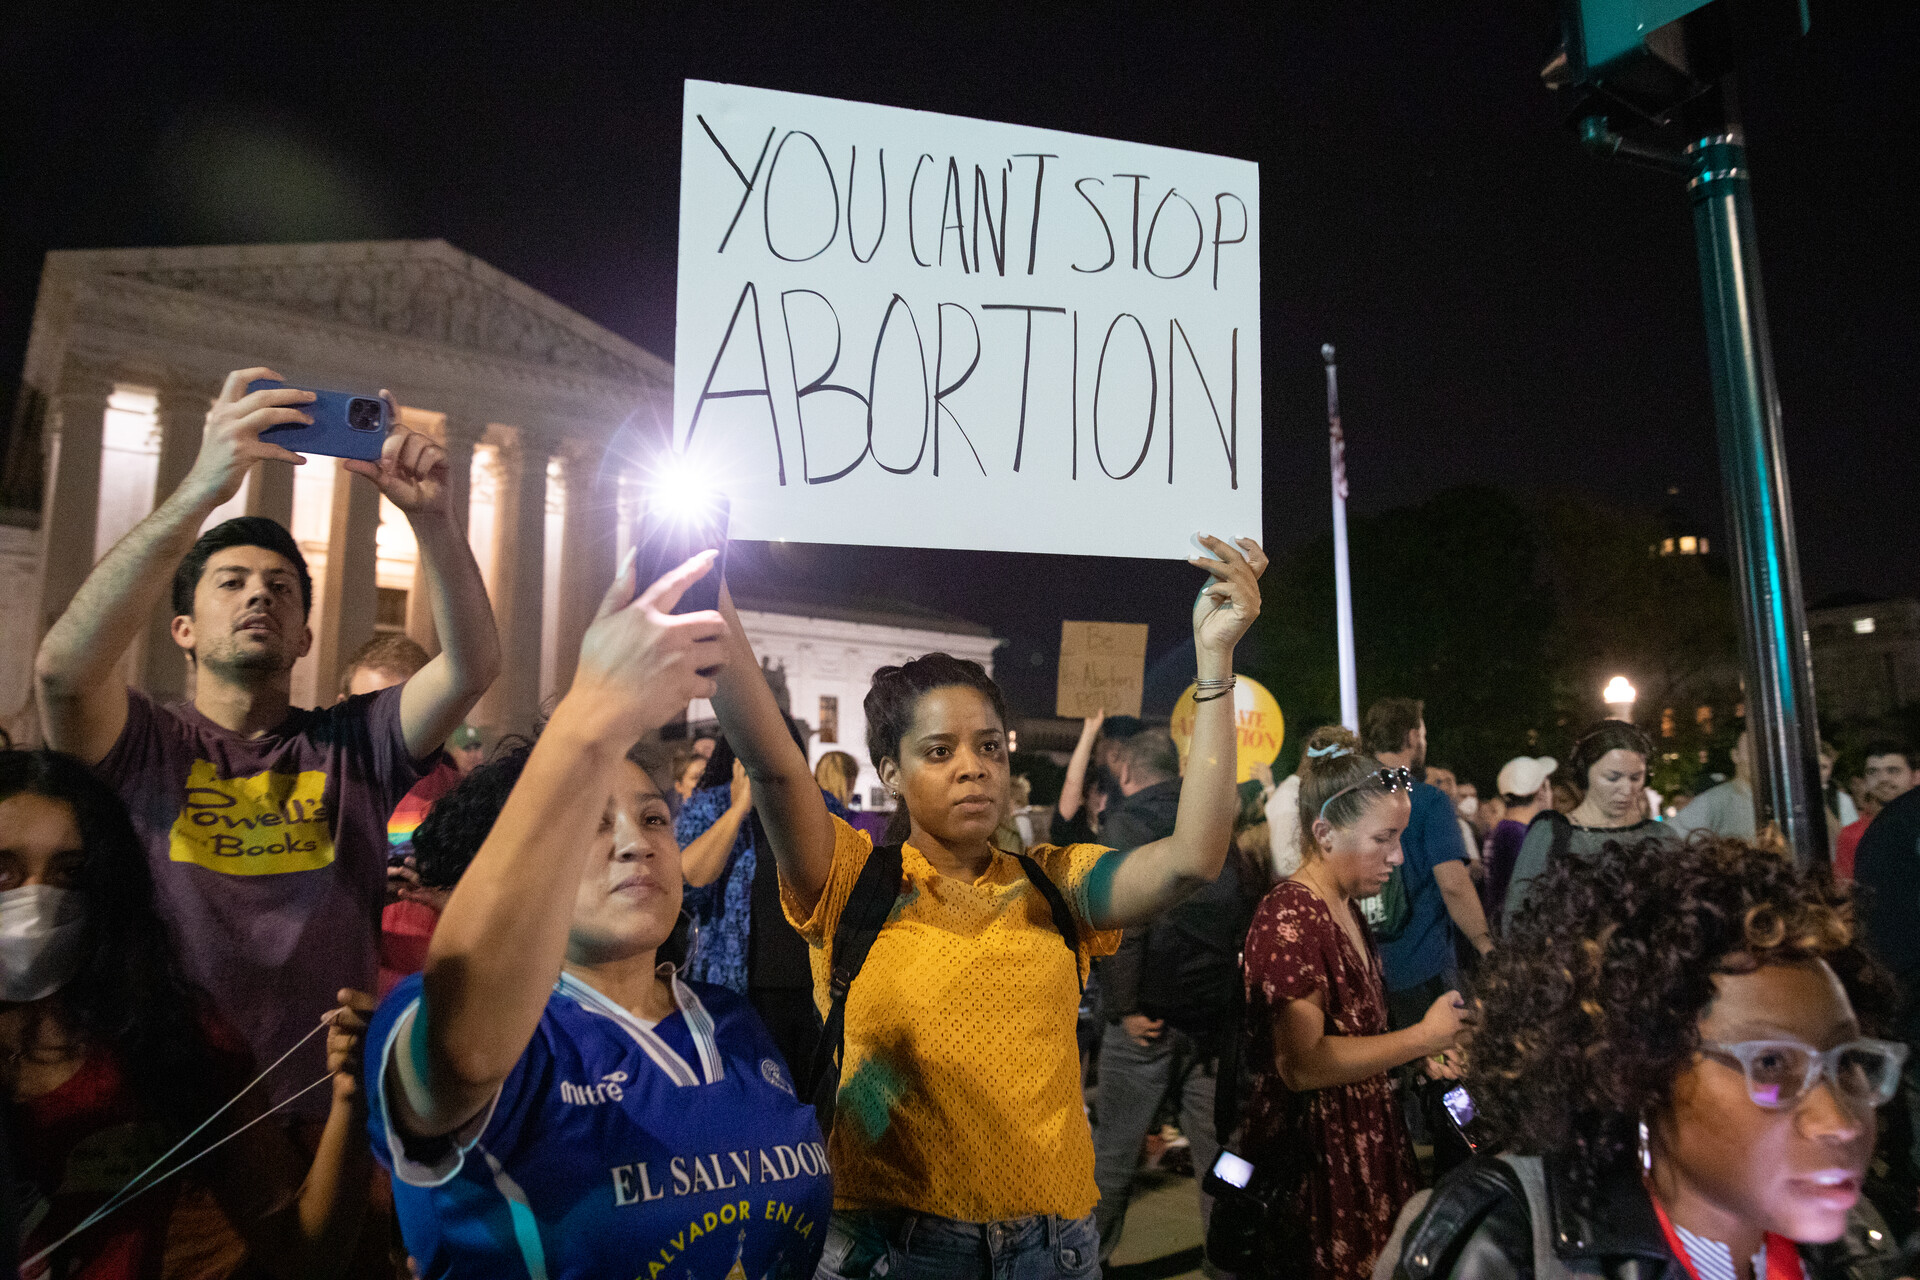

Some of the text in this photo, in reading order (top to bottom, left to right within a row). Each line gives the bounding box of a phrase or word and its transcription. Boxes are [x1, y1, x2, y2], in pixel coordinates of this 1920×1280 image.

[696, 113, 1248, 291] YOU CAN'T STOP
[683, 280, 1240, 490] ABORTION
[183, 787, 330, 830] Powell's
[210, 831, 317, 858] Books
[560, 1076, 626, 1105] mitre
[609, 1141, 830, 1206] EL SALVADOR
[764, 1200, 794, 1224] EN
[793, 1212, 815, 1240] LA
